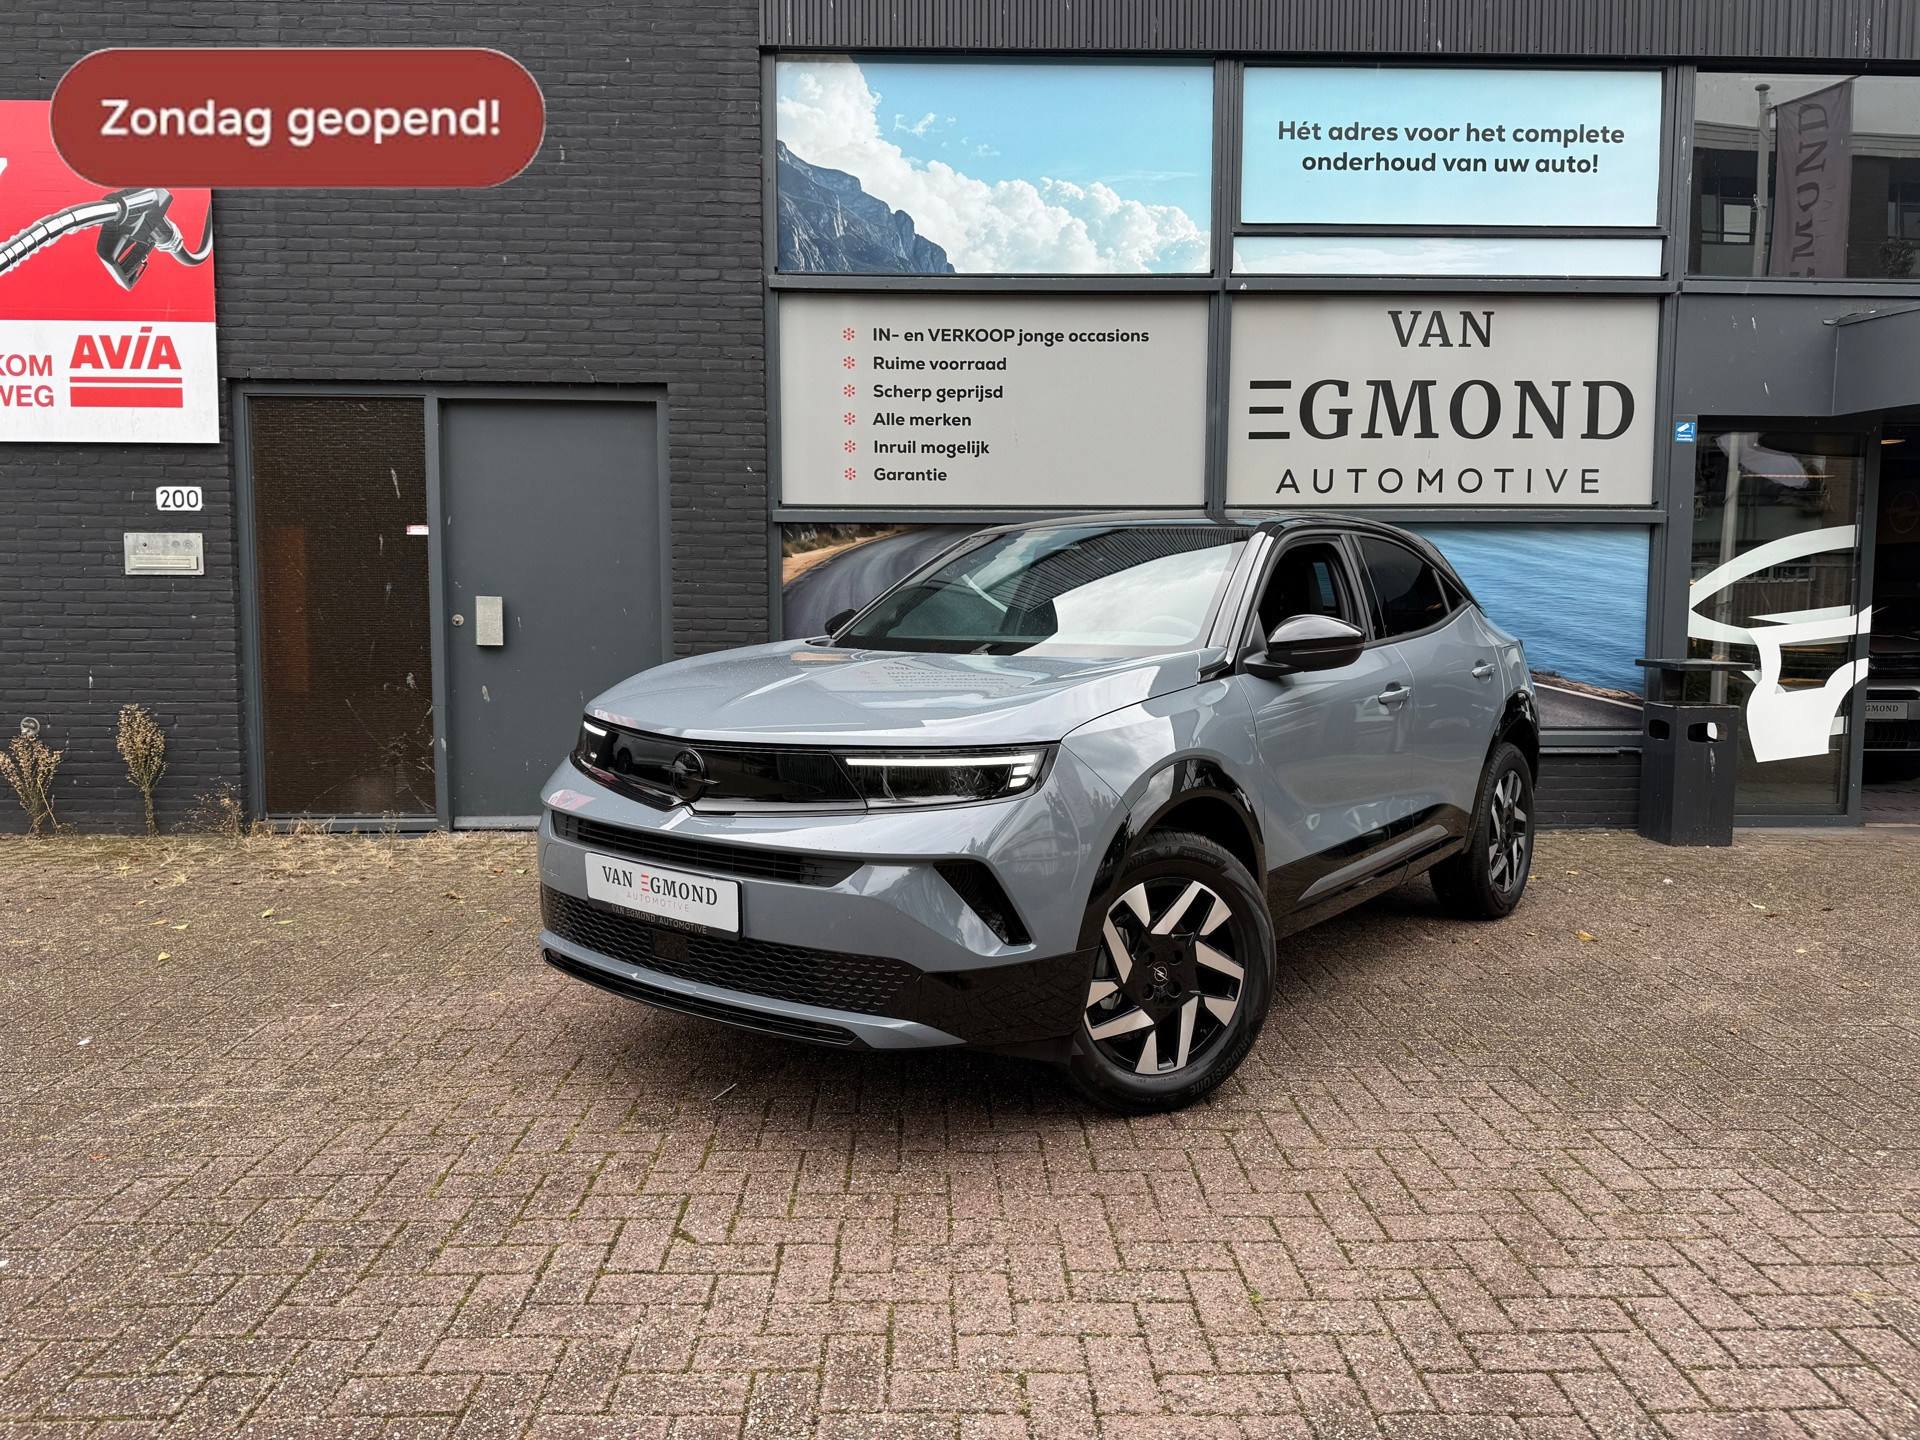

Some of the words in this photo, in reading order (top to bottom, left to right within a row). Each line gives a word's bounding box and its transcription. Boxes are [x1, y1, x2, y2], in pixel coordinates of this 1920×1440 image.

[1278, 120, 1322, 141] Hét
[1328, 121, 1399, 142] adres
[1403, 127, 1461, 142] voor
[1466, 122, 1506, 142] het
[1512, 124, 1625, 149] complete
[1302, 151, 1436, 172] onderhoud
[1442, 157, 1488, 172] van
[1494, 158, 1531, 173] uw
[1535, 154, 1599, 173] auto!
[1789, 103, 1829, 277] MOND
[873, 327, 900, 342] IN-
[903, 331, 924, 342] en
[928, 328, 1015, 343] VERKOOP
[1016, 328, 1065, 347] jonge
[1068, 329, 1150, 343] occasions
[1387, 310, 1495, 348] VAN
[873, 356, 926, 371] Ruime
[928, 357, 1007, 371] voorraad
[873, 384, 932, 402] Scherp
[936, 384, 1003, 403] geprijsd
[872, 412, 906, 426] Alle
[909, 412, 972, 427] merken
[1248, 379, 1635, 440] EGMOND
[873, 440, 916, 454] Inruil
[920, 440, 990, 458] mogelijk
[873, 467, 948, 482] Garantie
[1275, 467, 1600, 494] AUTOMOTIVE
[160, 489, 199, 509] 200
[602, 866, 633, 888] VAN
[641, 874, 718, 906] EGMOND
[626, 891, 690, 913] AUTOMOTIVE
[611, 904, 625, 916] VAN
[626, 908, 656, 923] EGMOND
[658, 917, 707, 935] AUTOMOTIVE
[1188, 1031, 1255, 1097] BRIDGESTONE
